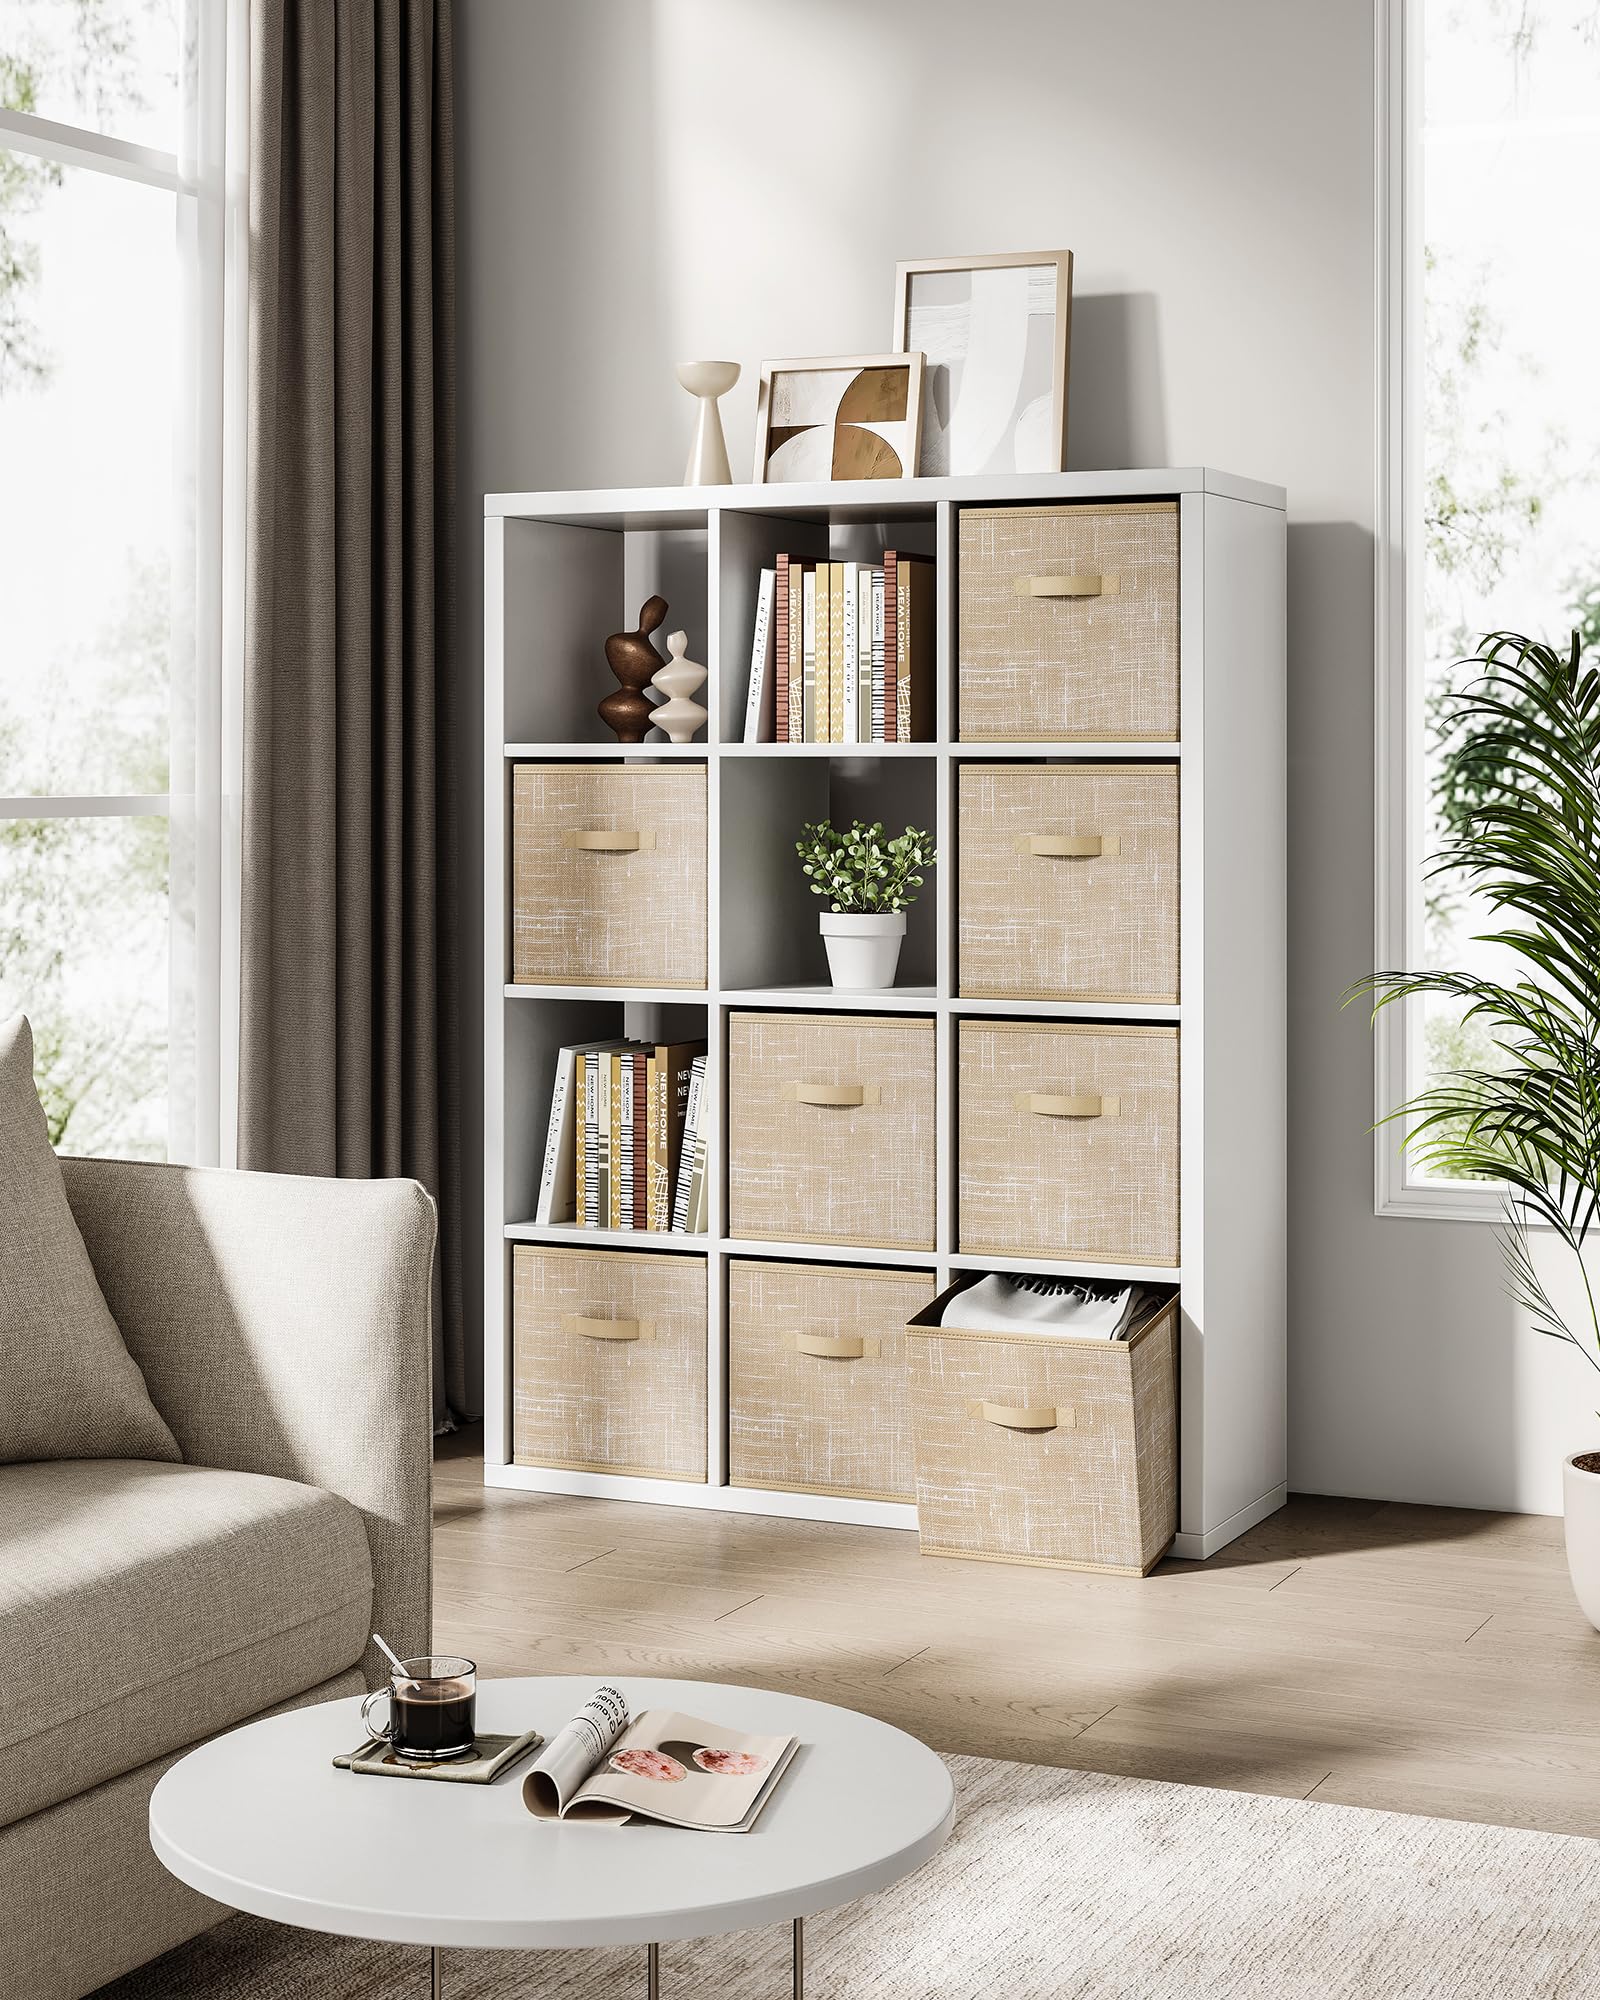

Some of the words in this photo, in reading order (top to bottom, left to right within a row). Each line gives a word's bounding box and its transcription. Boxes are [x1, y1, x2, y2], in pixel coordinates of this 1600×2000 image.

[553, 1076, 566, 1134] TRAVEL
[677, 1085, 689, 1097] NE
[546, 1147, 556, 1187] BOOK
